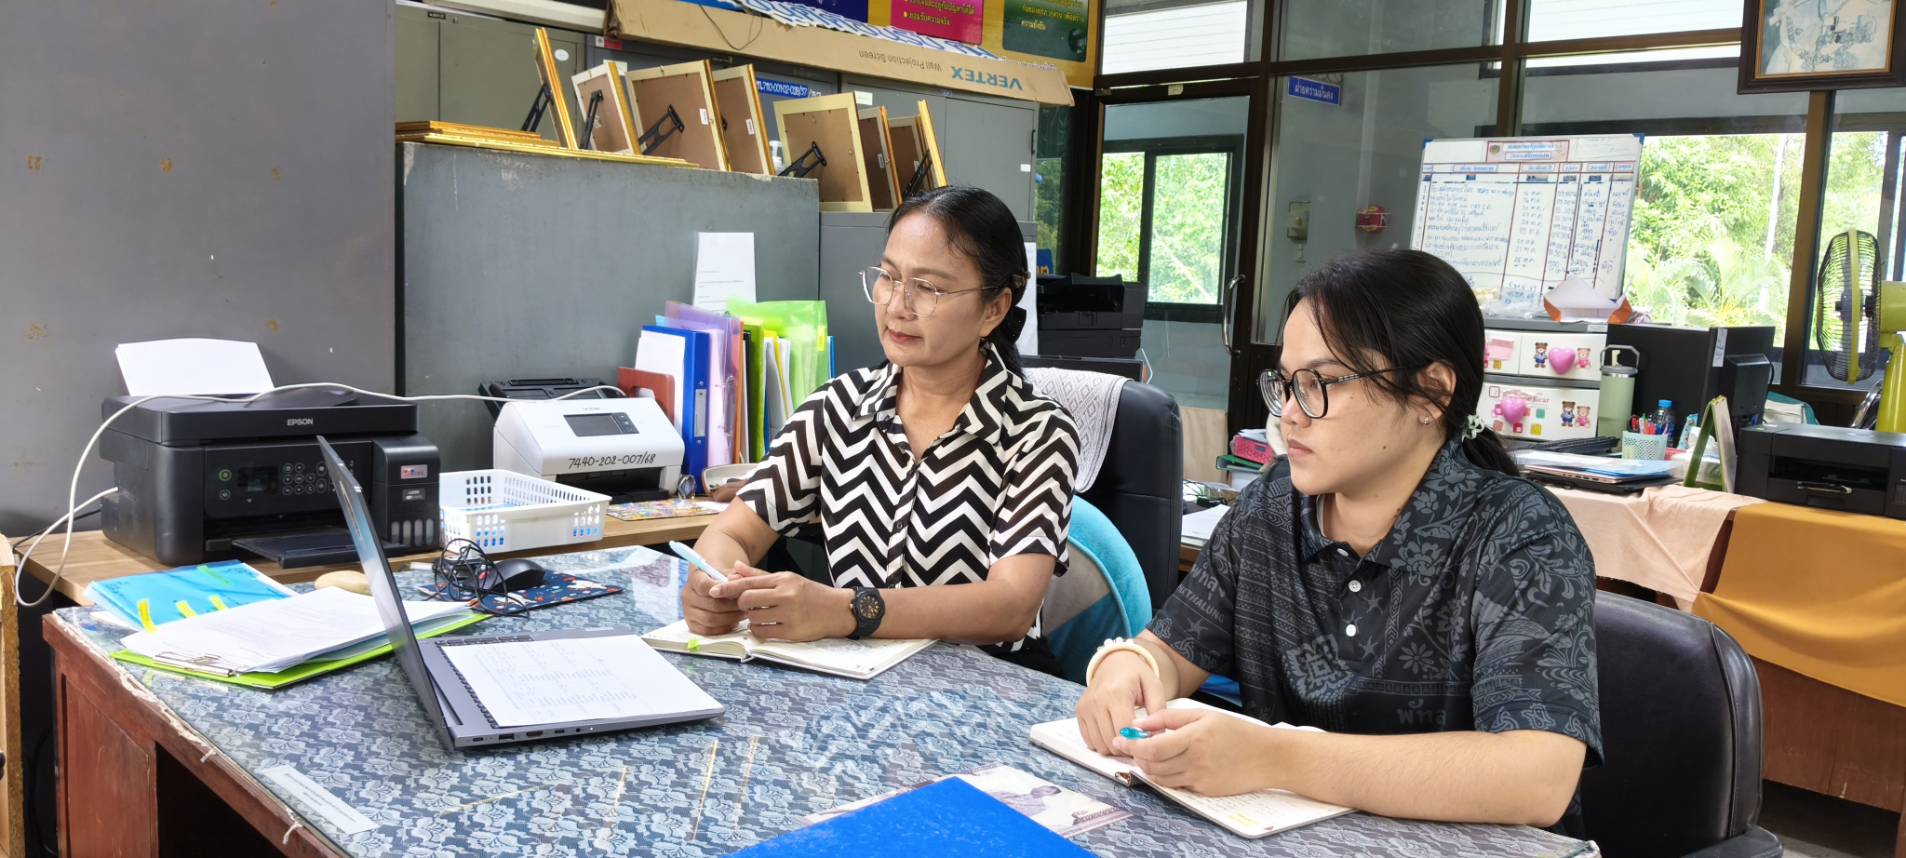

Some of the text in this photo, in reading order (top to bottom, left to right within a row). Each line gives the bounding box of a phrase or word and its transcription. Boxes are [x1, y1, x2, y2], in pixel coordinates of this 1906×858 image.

[858, 50, 943, 73] Wall Projection Screen
[951, 65, 1023, 91] VERTEX
[287, 418, 314, 426] EPSON
[568, 451, 656, 469] 7440-202-007/68
